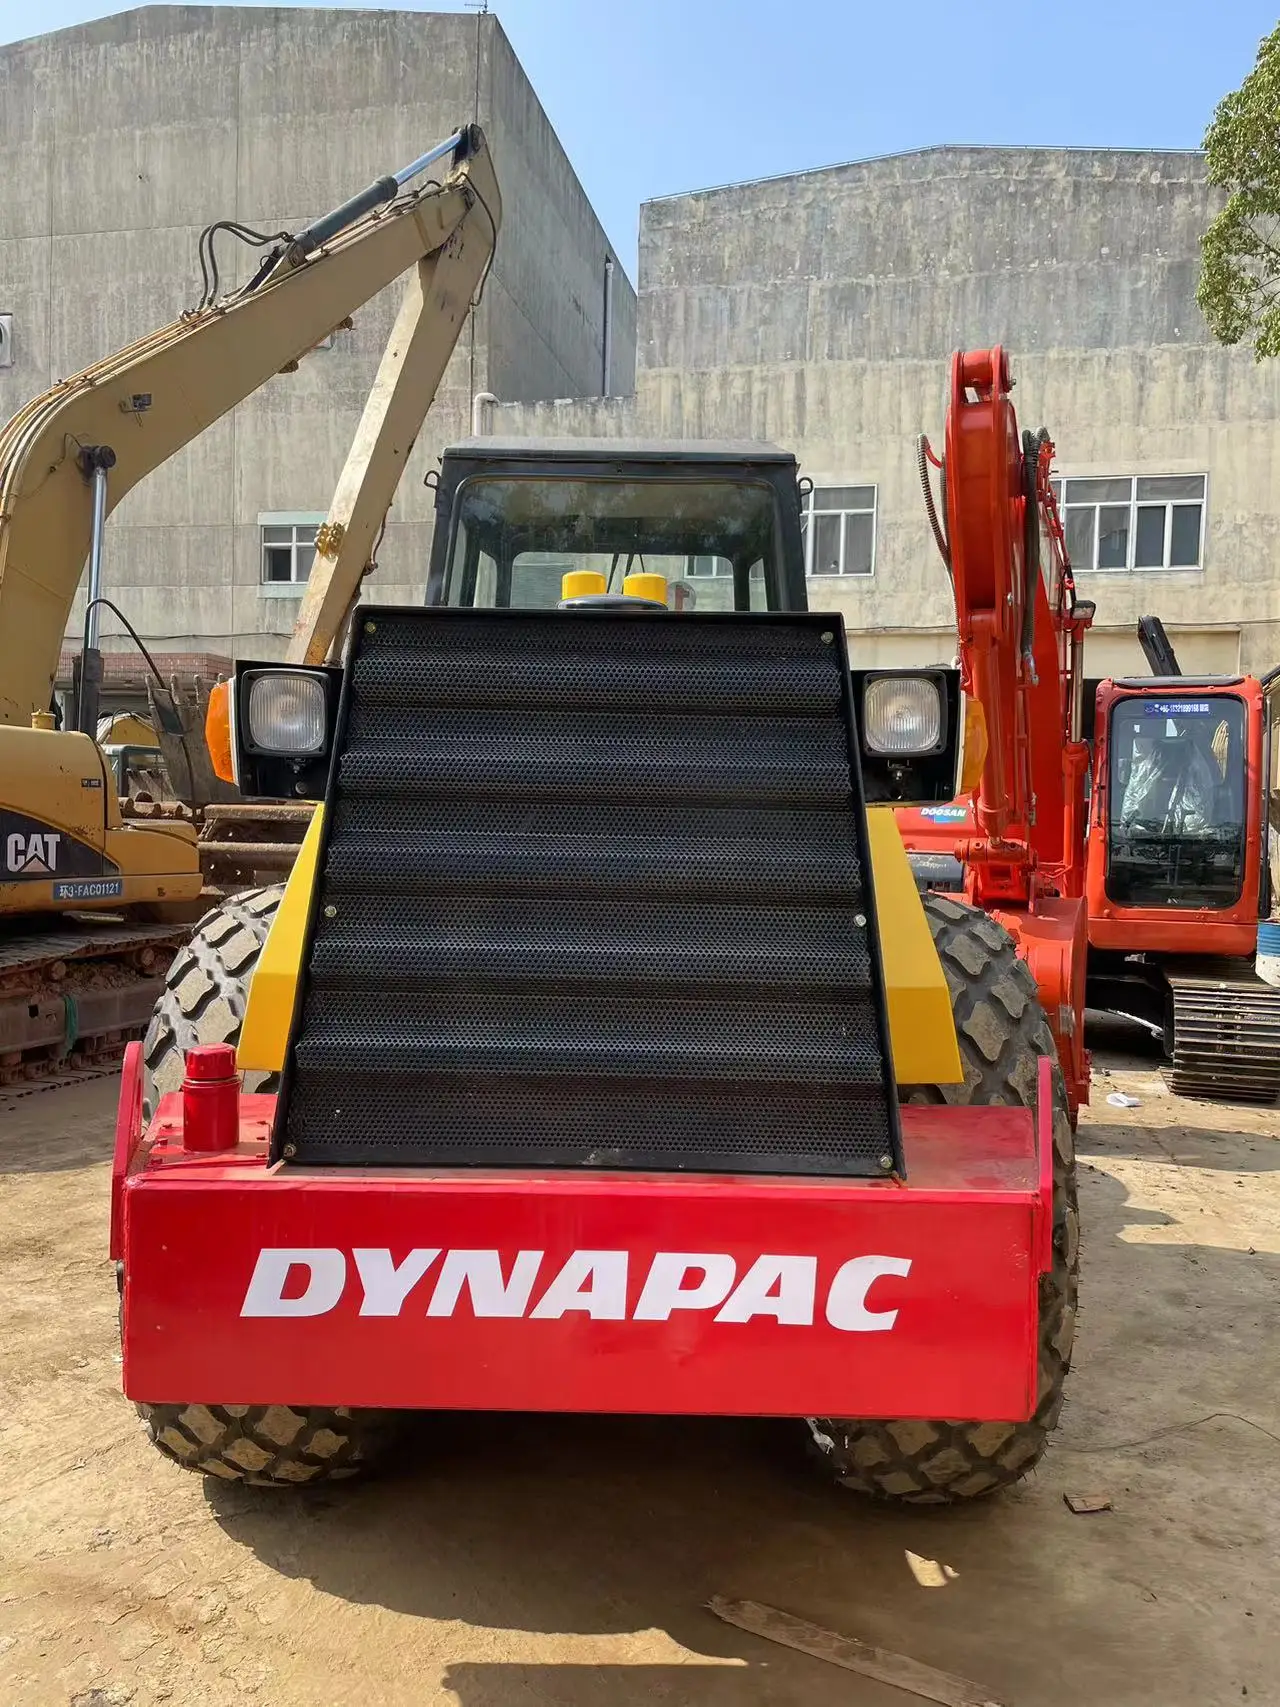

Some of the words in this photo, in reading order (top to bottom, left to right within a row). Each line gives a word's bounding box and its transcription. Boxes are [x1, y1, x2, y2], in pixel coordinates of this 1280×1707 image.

[921, 807, 967, 817] DOOSAN
[7, 833, 61, 872] CAT
[239, 1247, 912, 1331] DYNAPAC
